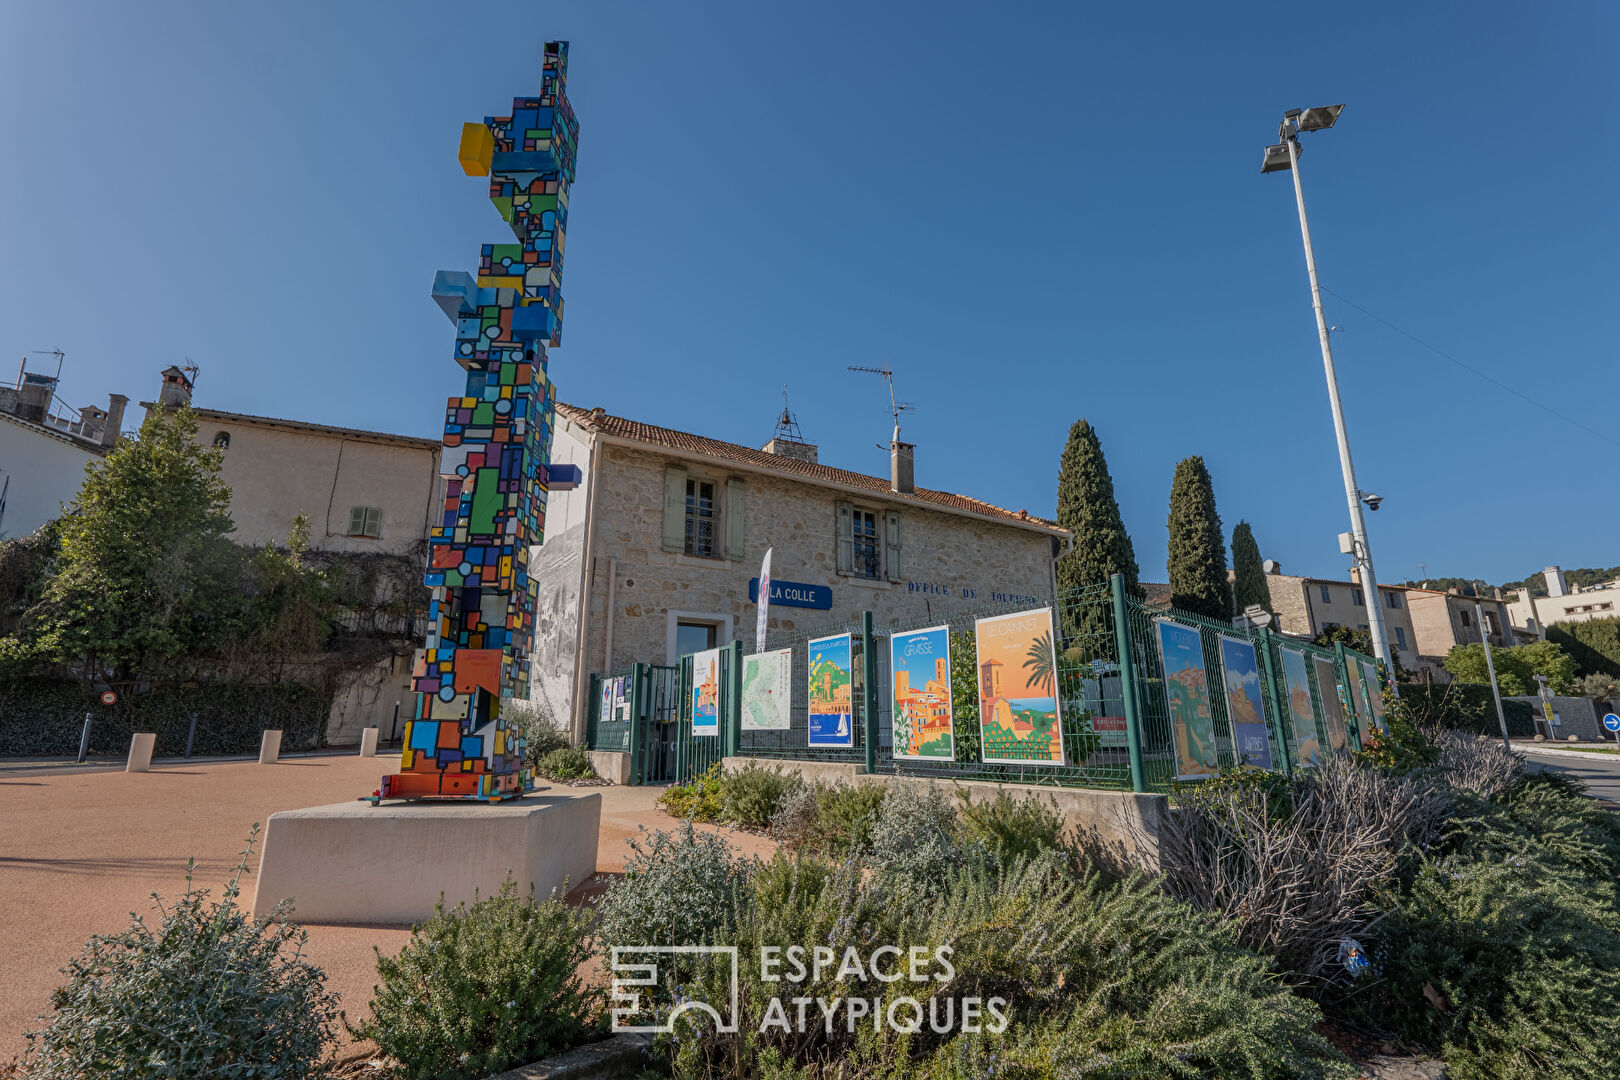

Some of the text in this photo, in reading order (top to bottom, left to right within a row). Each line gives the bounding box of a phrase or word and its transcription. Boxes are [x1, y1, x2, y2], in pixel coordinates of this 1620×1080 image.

[769, 587, 816, 603] LA COLLE
[908, 581, 949, 596] OFFICE
[963, 588, 977, 600] DE
[998, 617, 1038, 636] CANNET
[904, 642, 934, 656] GRASSE
